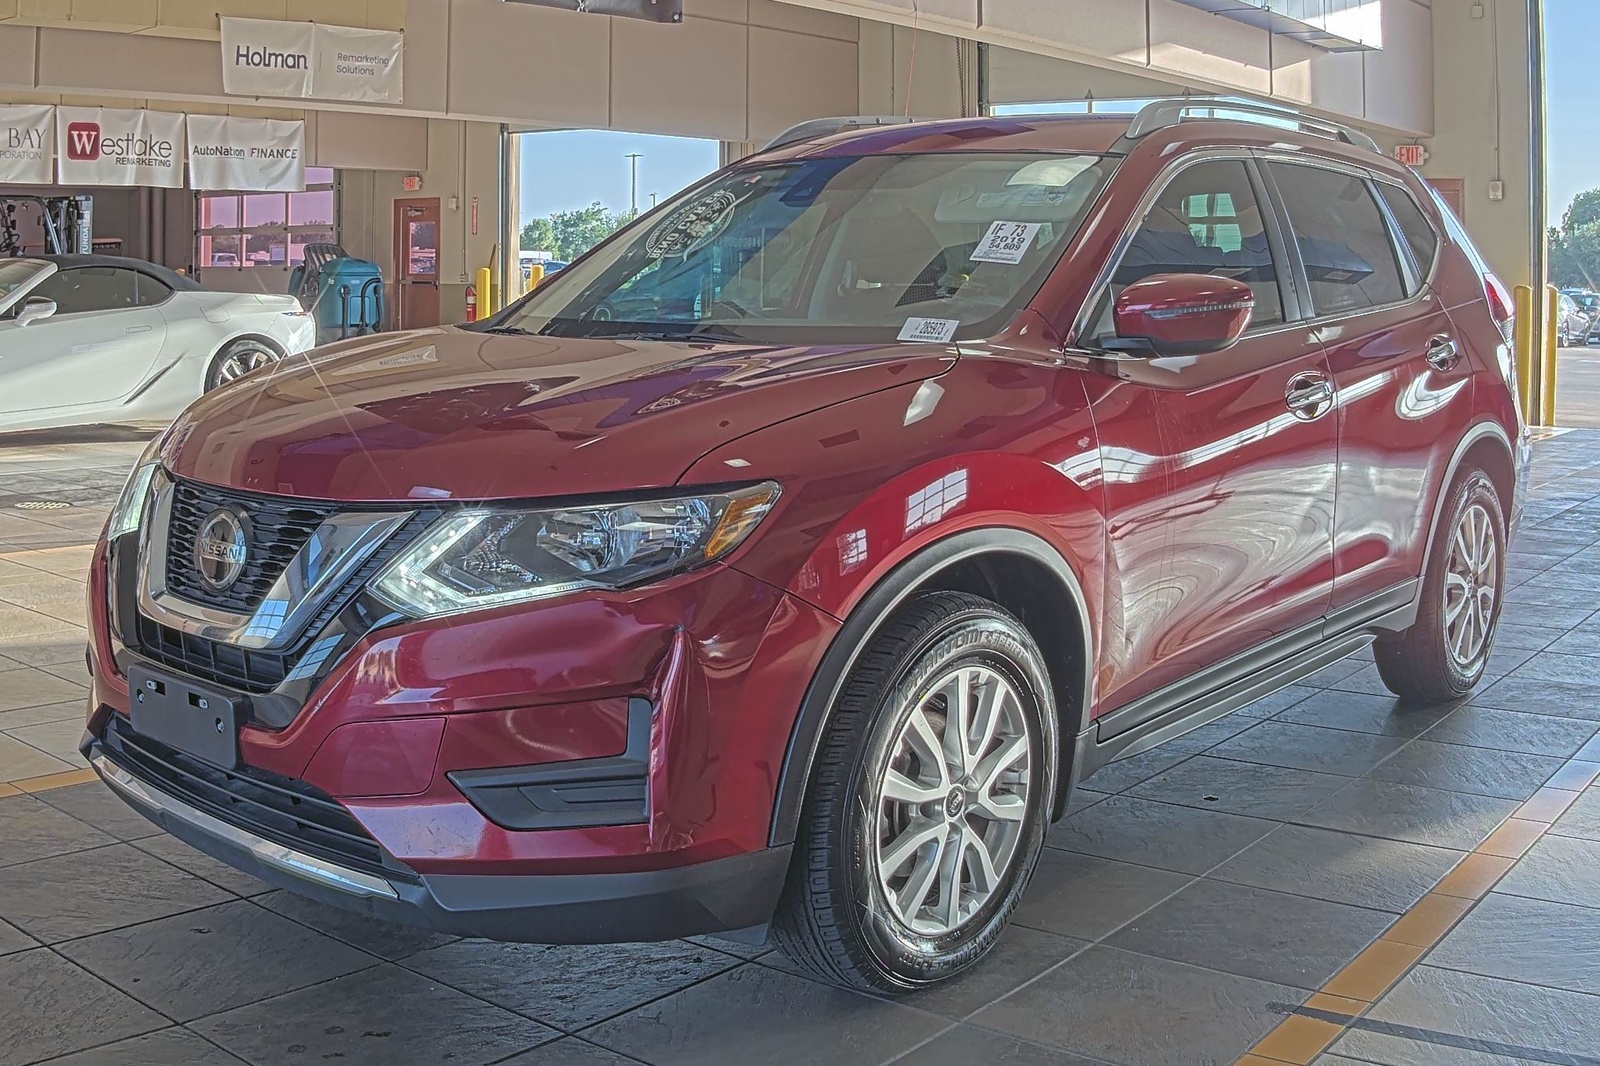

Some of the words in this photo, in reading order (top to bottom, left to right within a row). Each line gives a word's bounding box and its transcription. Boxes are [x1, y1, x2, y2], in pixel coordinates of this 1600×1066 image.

[235, 45, 308, 70] Holman
[337, 52, 390, 68] Remarketing
[336, 65, 375, 76] Solutions
[8, 127, 46, 149] BAY
[70, 130, 173, 158] Westlake
[192, 145, 246, 160] AutoNation
[250, 147, 298, 159] FINANCE
[1400, 146, 1420, 164] EXIT
[115, 157, 171, 168] REMARKETING
[991, 223, 1007, 235] IF
[1010, 224, 1027, 237] 73
[991, 235, 1026, 245] 2019
[200, 542, 241, 559] NISSAN
